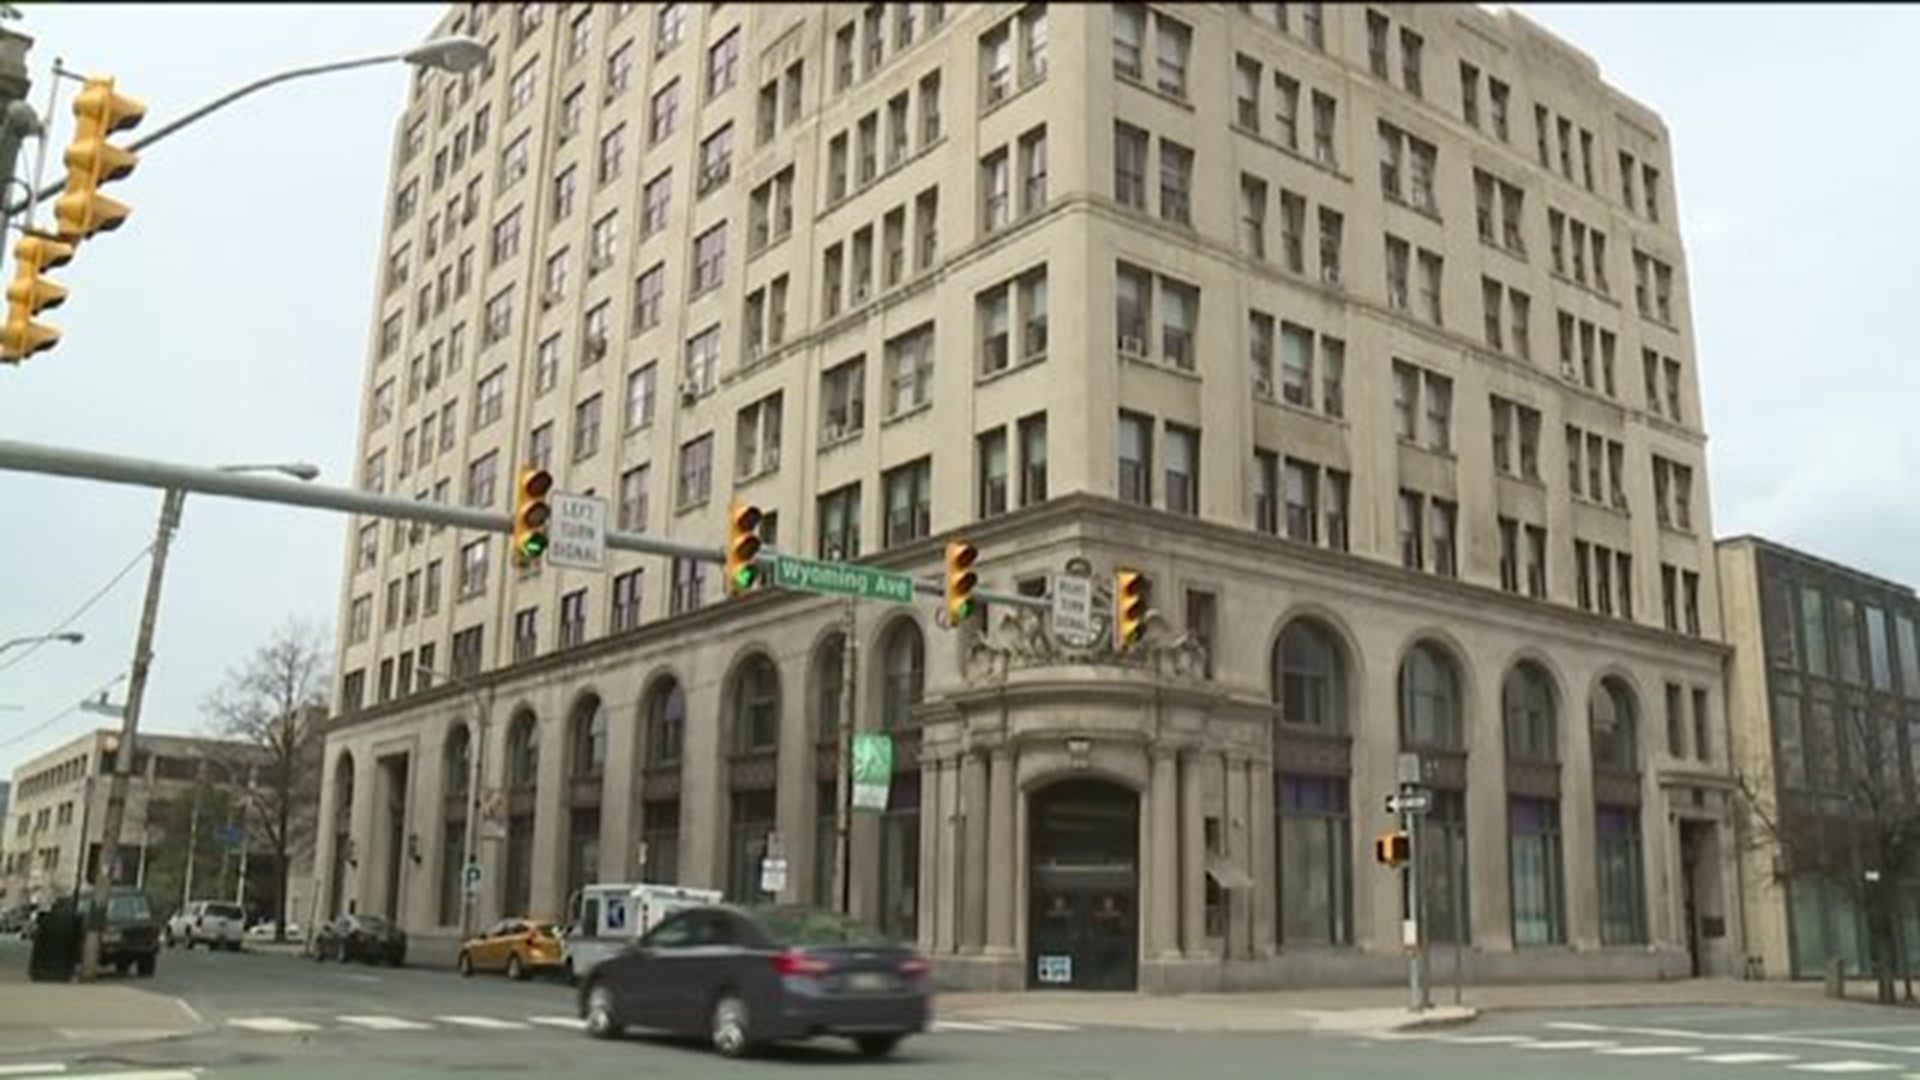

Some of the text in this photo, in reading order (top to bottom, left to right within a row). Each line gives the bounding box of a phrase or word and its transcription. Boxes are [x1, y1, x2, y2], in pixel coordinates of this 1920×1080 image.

[562, 501, 595, 521] LEFT
[560, 521, 596, 541] TURN
[552, 541, 600, 564] SIGNAL
[781, 560, 908, 597] Wyoming Ave
